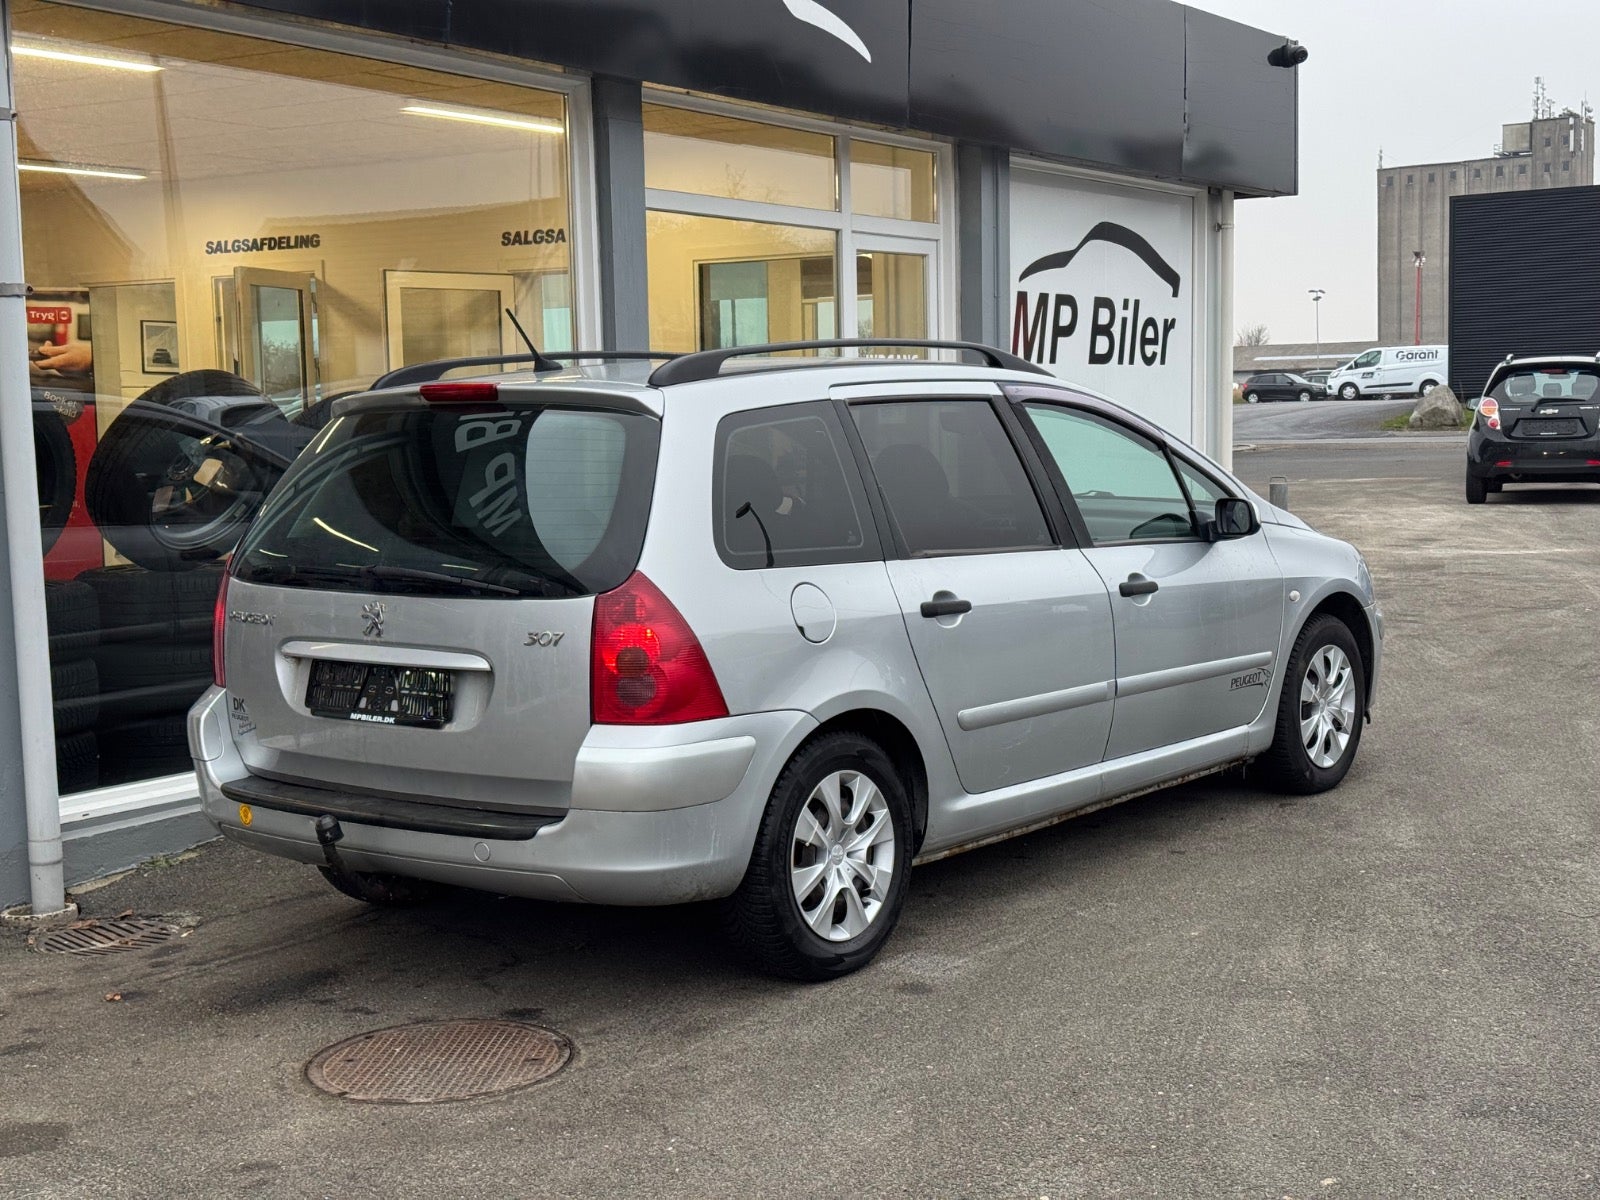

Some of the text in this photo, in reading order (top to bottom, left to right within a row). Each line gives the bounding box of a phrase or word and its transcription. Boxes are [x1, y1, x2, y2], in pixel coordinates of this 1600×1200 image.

[205, 234, 320, 254] SALGSAFDELING
[501, 229, 566, 246] SALGSA
[30, 311, 55, 321] Tryg
[1012, 291, 1176, 366] MP Biler
[1395, 350, 1438, 360] Garant
[523, 630, 565, 647] 307
[1230, 671, 1261, 689] PEUGEOT
[233, 697, 246, 712] DK
[350, 712, 396, 724] MPBILER.DK
